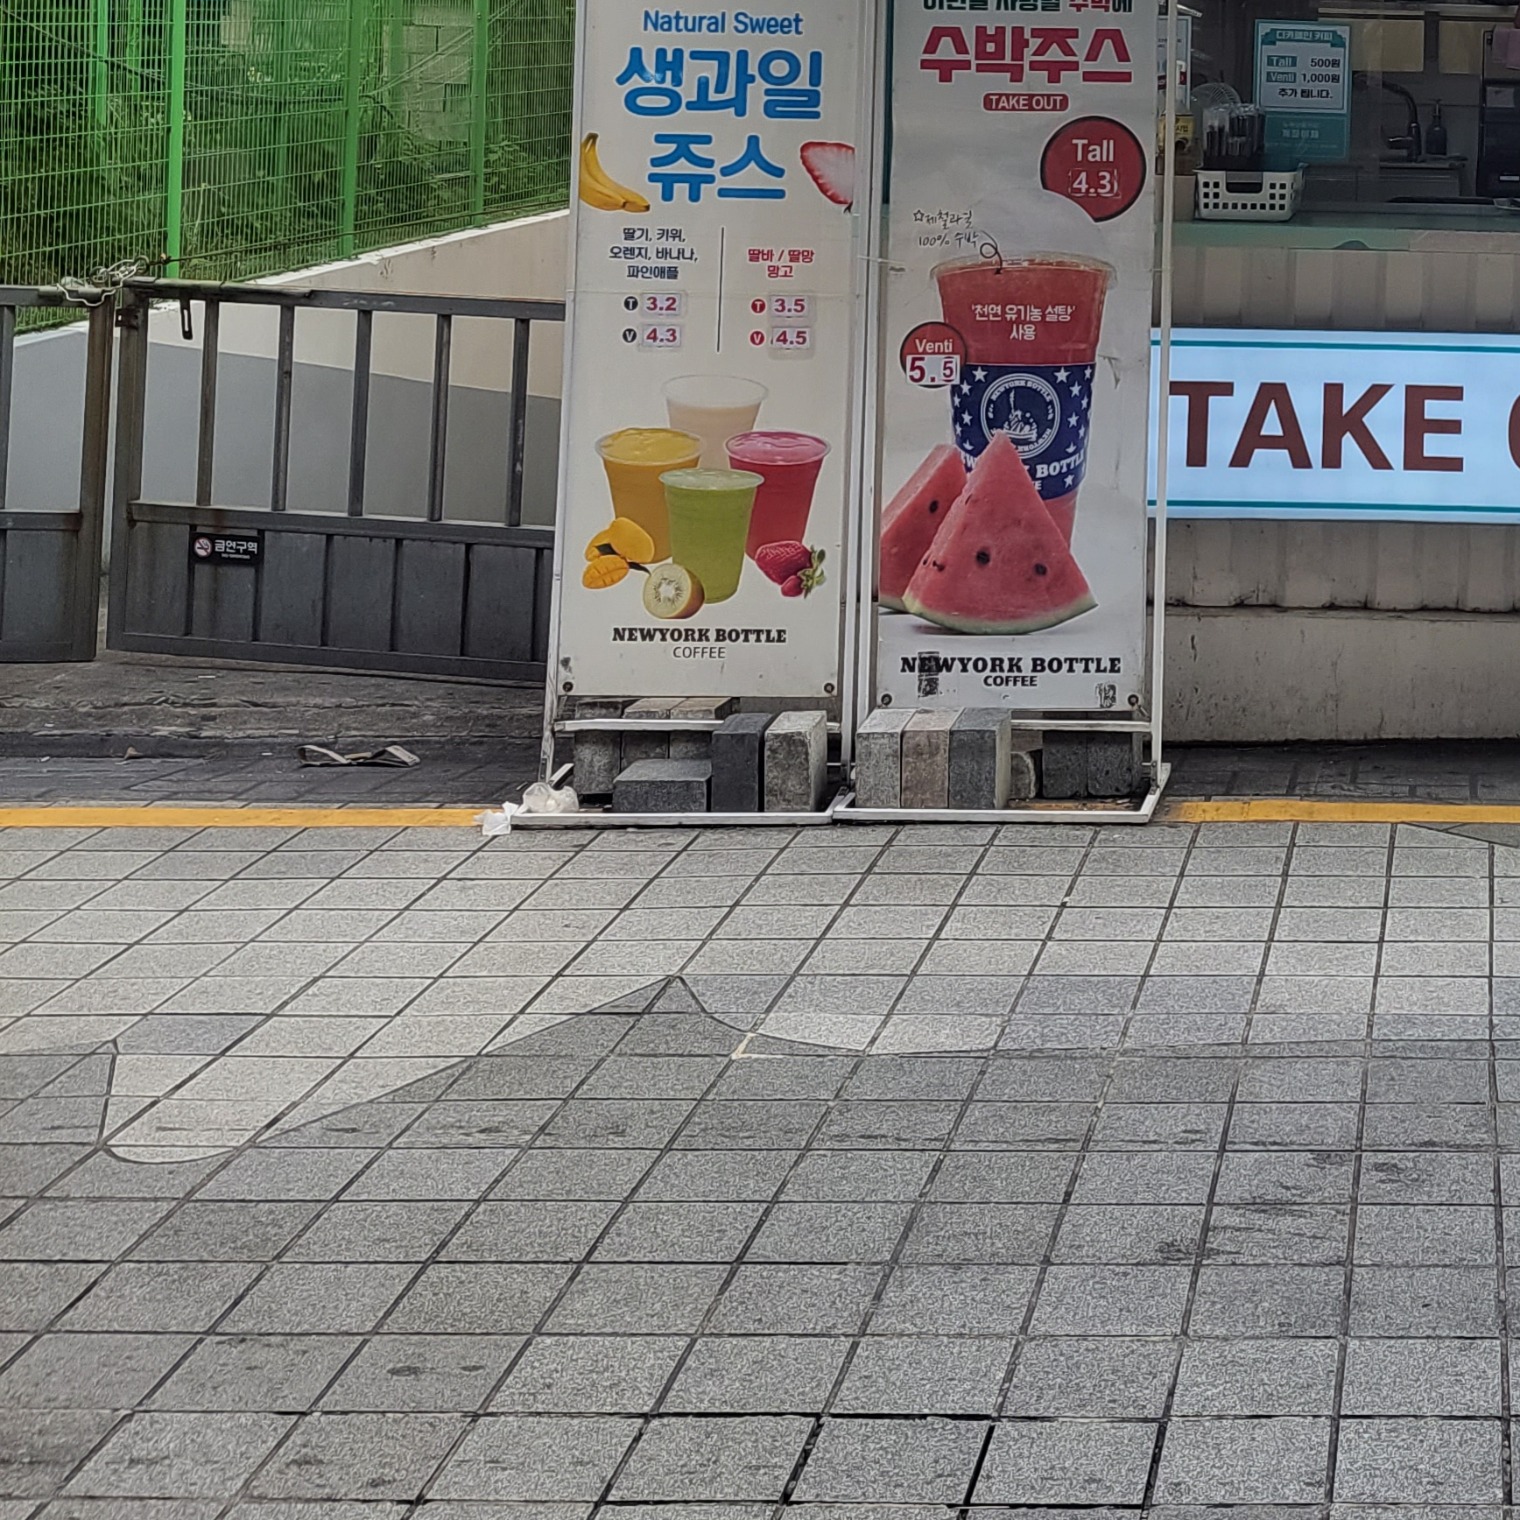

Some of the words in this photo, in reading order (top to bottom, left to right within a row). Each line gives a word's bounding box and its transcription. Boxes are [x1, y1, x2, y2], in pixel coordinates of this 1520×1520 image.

[643, 10, 726, 34] Natural
[733, 12, 804, 35] Sweet
[1276, 31, 1312, 41] 디카페인
[1314, 31, 1333, 41] 커피
[919, 26, 1132, 84] 수박주스
[1310, 58, 1340, 68] 500원
[615, 46, 823, 119] 생과일
[1301, 73, 1340, 84] 1,000원
[1278, 88, 1297, 98] 추가
[1300, 89, 1333, 98] 됩니다.
[990, 96, 1029, 110] TAKE
[1032, 96, 1063, 111] OUT
[1072, 139, 1114, 162] Tall
[647, 133, 786, 202] 쥬스
[623, 228, 652, 242] 딸기,
[656, 228, 686, 243] 키위,
[919, 233, 950, 247] 100%
[954, 232, 979, 248] 수박
[609, 246, 652, 260] 오렌지,
[655, 247, 698, 263] 바나나,
[748, 249, 775, 263] 딸바
[788, 249, 815, 263] 딸망
[627, 265, 679, 280] 파인애플
[767, 265, 794, 278] 망고
[646, 296, 677, 311] 3.2
[774, 298, 805, 313] 3.5
[1005, 305, 1042, 321] 유기농
[646, 328, 677, 342] 4.3
[776, 330, 807, 345] 4.5
[1010, 324, 1036, 340] 사용
[915, 338, 953, 353] Venti
[907, 355, 955, 383] 5.5
[1169, 380, 1464, 472] TAKE
[215, 539, 258, 555] 금연구역
[612, 628, 711, 642] NEWYORK
[714, 628, 787, 643] BOTTLE
[673, 647, 726, 658] COFFEE
[900, 657, 1022, 674] NEWYORK
[1031, 657, 1121, 674] BOTTLE
[983, 675, 1038, 687] COFFEE
